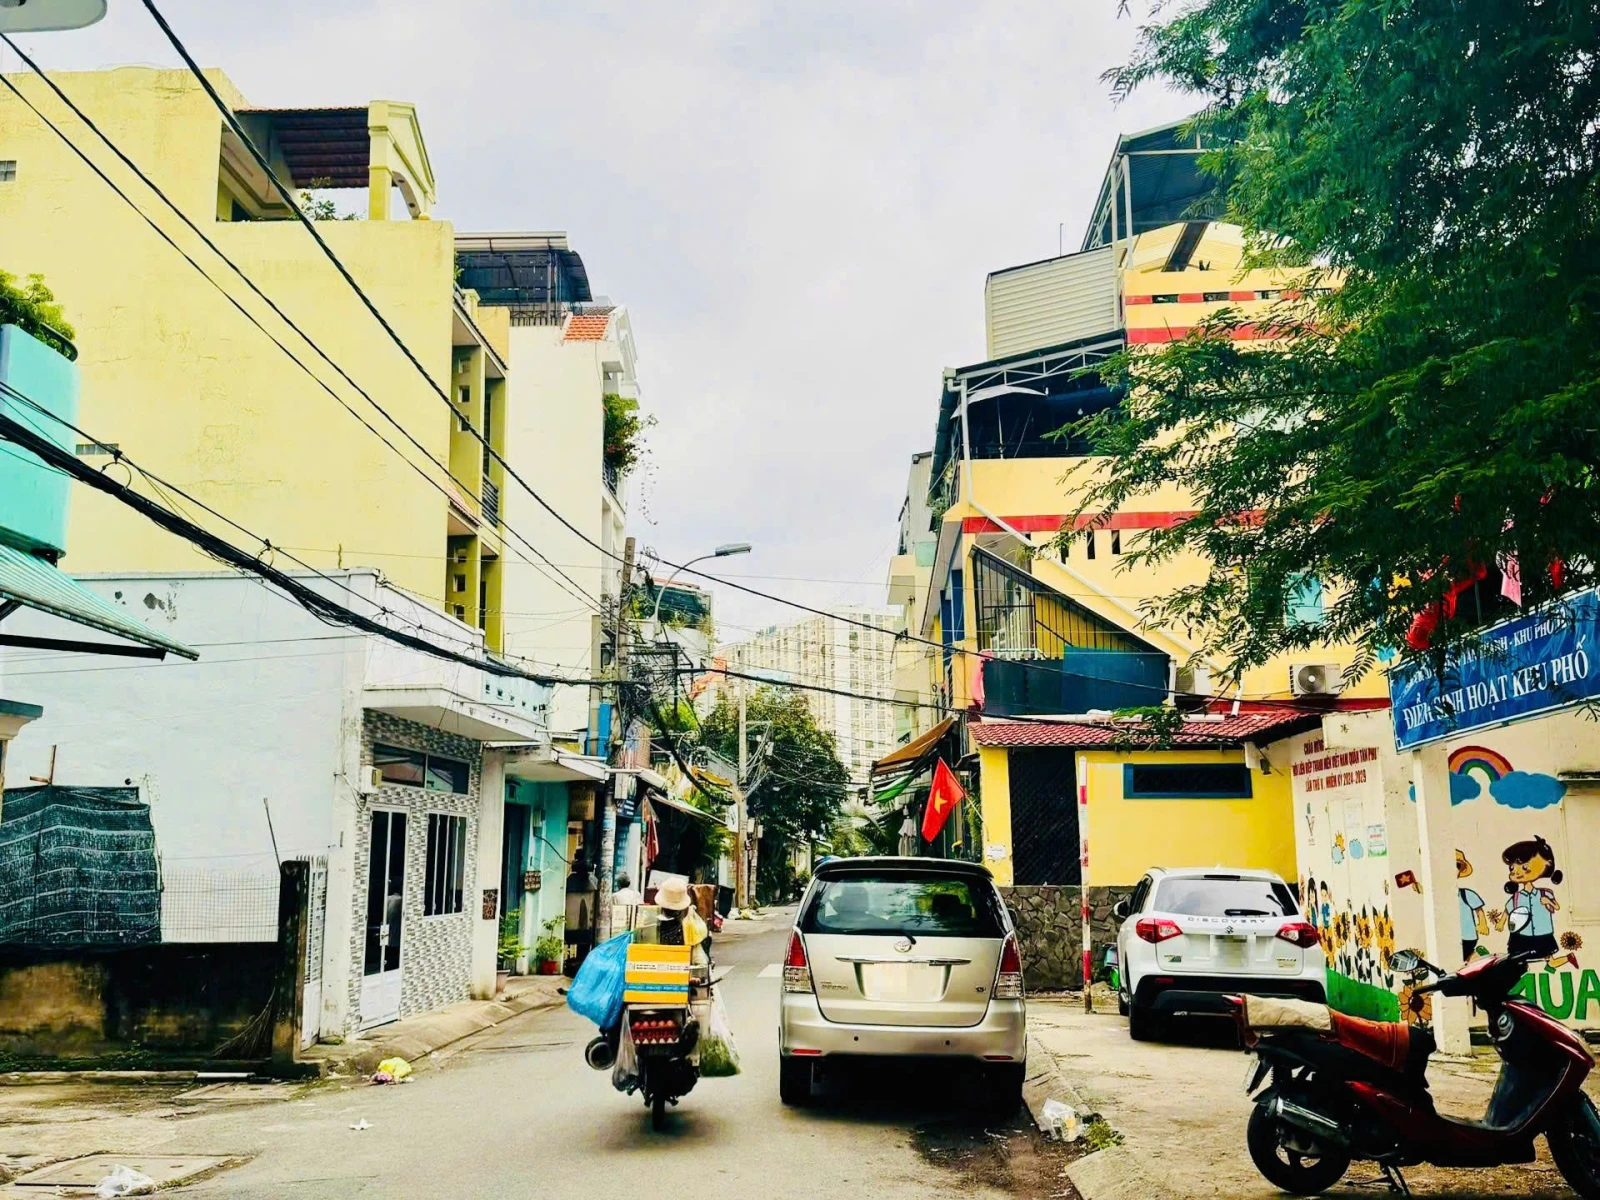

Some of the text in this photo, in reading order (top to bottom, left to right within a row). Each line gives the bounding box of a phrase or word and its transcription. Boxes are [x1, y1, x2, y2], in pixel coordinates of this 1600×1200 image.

[1513, 626, 1533, 647] KHU
[1466, 674, 1507, 711] HOẠT
[1551, 634, 1588, 685] PHỐ
[1340, 753, 1348, 767] NAM
